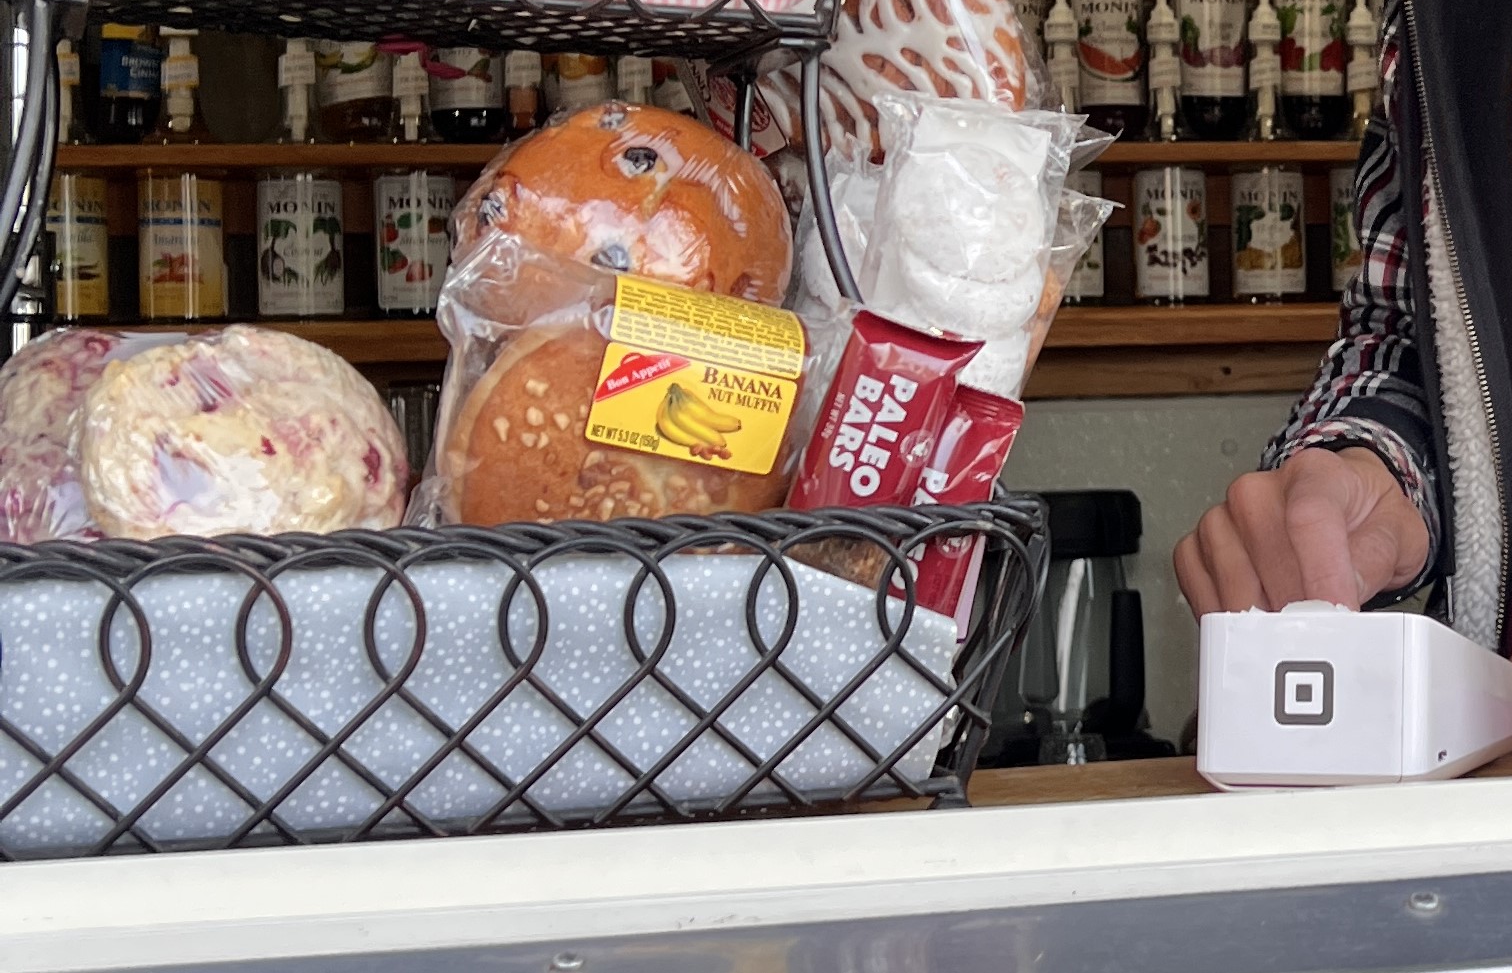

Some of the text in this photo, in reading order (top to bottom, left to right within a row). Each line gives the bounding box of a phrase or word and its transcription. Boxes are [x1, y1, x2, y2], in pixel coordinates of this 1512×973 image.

[267, 200, 336, 215] MONIN
[388, 195, 456, 211] MONIN
[606, 375, 630, 391] Bon
[700, 366, 783, 400] BANANA
[707, 387, 782, 415] NUT MUFFIN
[590, 424, 606, 438] NET
[606, 427, 618, 440] WT
[829, 374, 885, 473] BARS
[850, 374, 919, 498] PALEO
